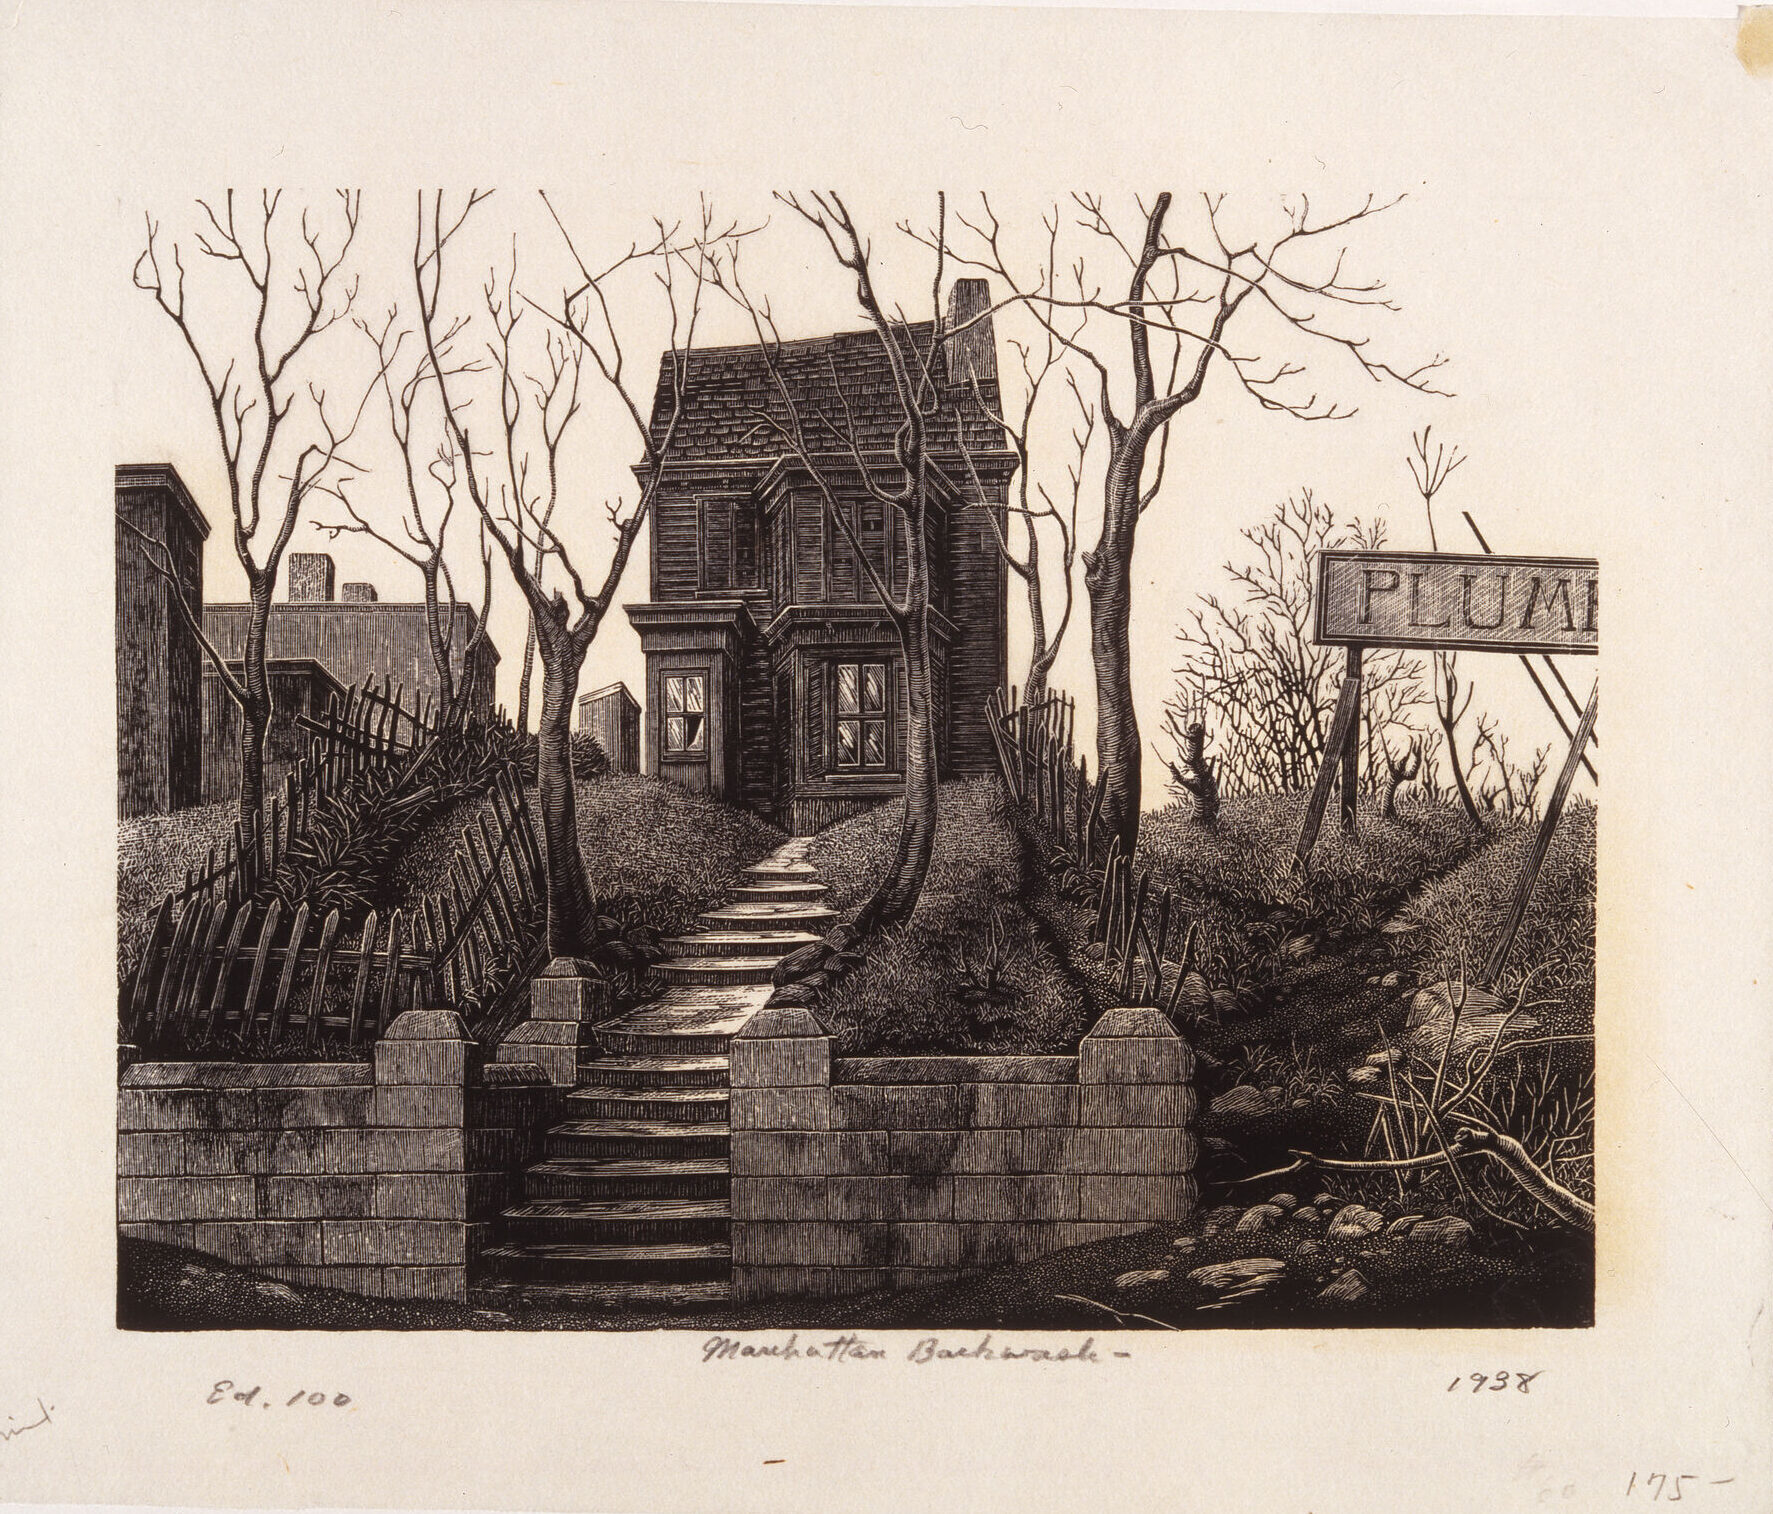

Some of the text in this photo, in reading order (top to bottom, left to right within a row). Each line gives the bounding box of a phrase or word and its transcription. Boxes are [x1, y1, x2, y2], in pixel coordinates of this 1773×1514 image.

[701, 1334, 888, 1363] Manhattan
[1447, 1370, 1545, 1394] 1938
[286, 1390, 352, 1407] 100
